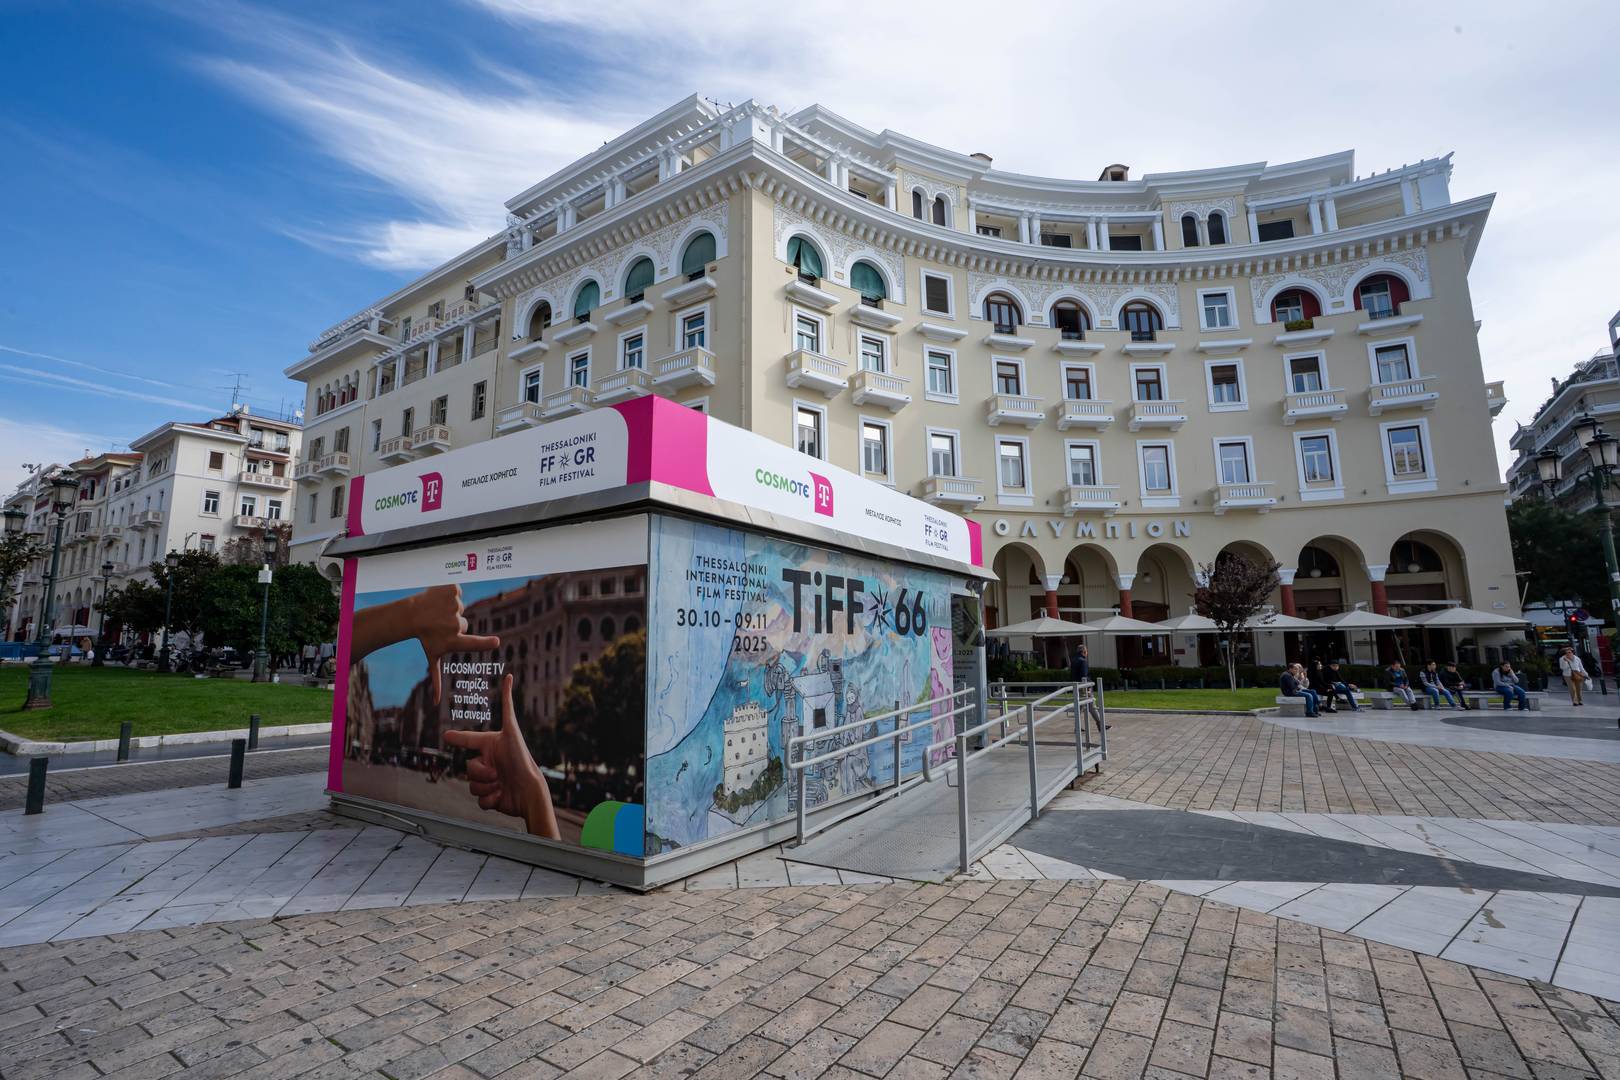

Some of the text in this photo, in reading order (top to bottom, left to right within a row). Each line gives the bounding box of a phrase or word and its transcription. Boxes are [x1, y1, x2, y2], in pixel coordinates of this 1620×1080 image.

[541, 432, 597, 453] THESSALONIKI
[540, 446, 595, 474] FF GR
[461, 467, 518, 488] ΜΕΓΑΛΟΣ ΧΟΡΗΓΟΣ
[539, 467, 595, 487] FILM FESTIVAL
[755, 468, 810, 498] COSMOTE
[375, 490, 418, 511] COSMOTE
[924, 524, 948, 541] FF GR
[993, 518, 1192, 538] ΟΛΥΜΠΙΟΝ
[502, 552, 513, 562] GR
[696, 555, 767, 575] THESSALONIKI
[685, 569, 767, 589] INTERNATIONAL
[696, 586, 767, 603] FILM FESTIVAL
[782, 568, 926, 637] TiFF 66
[677, 608, 720, 628] 30.10
[734, 611, 767, 629] 09.11
[734, 635, 767, 652] 2025
[450, 662, 492, 675] COSMOTE
[492, 662, 505, 675] TV
[455, 677, 489, 692] στηρίζει
[453, 692, 489, 707] το πάθος
[451, 709, 491, 723] για σινεμά
